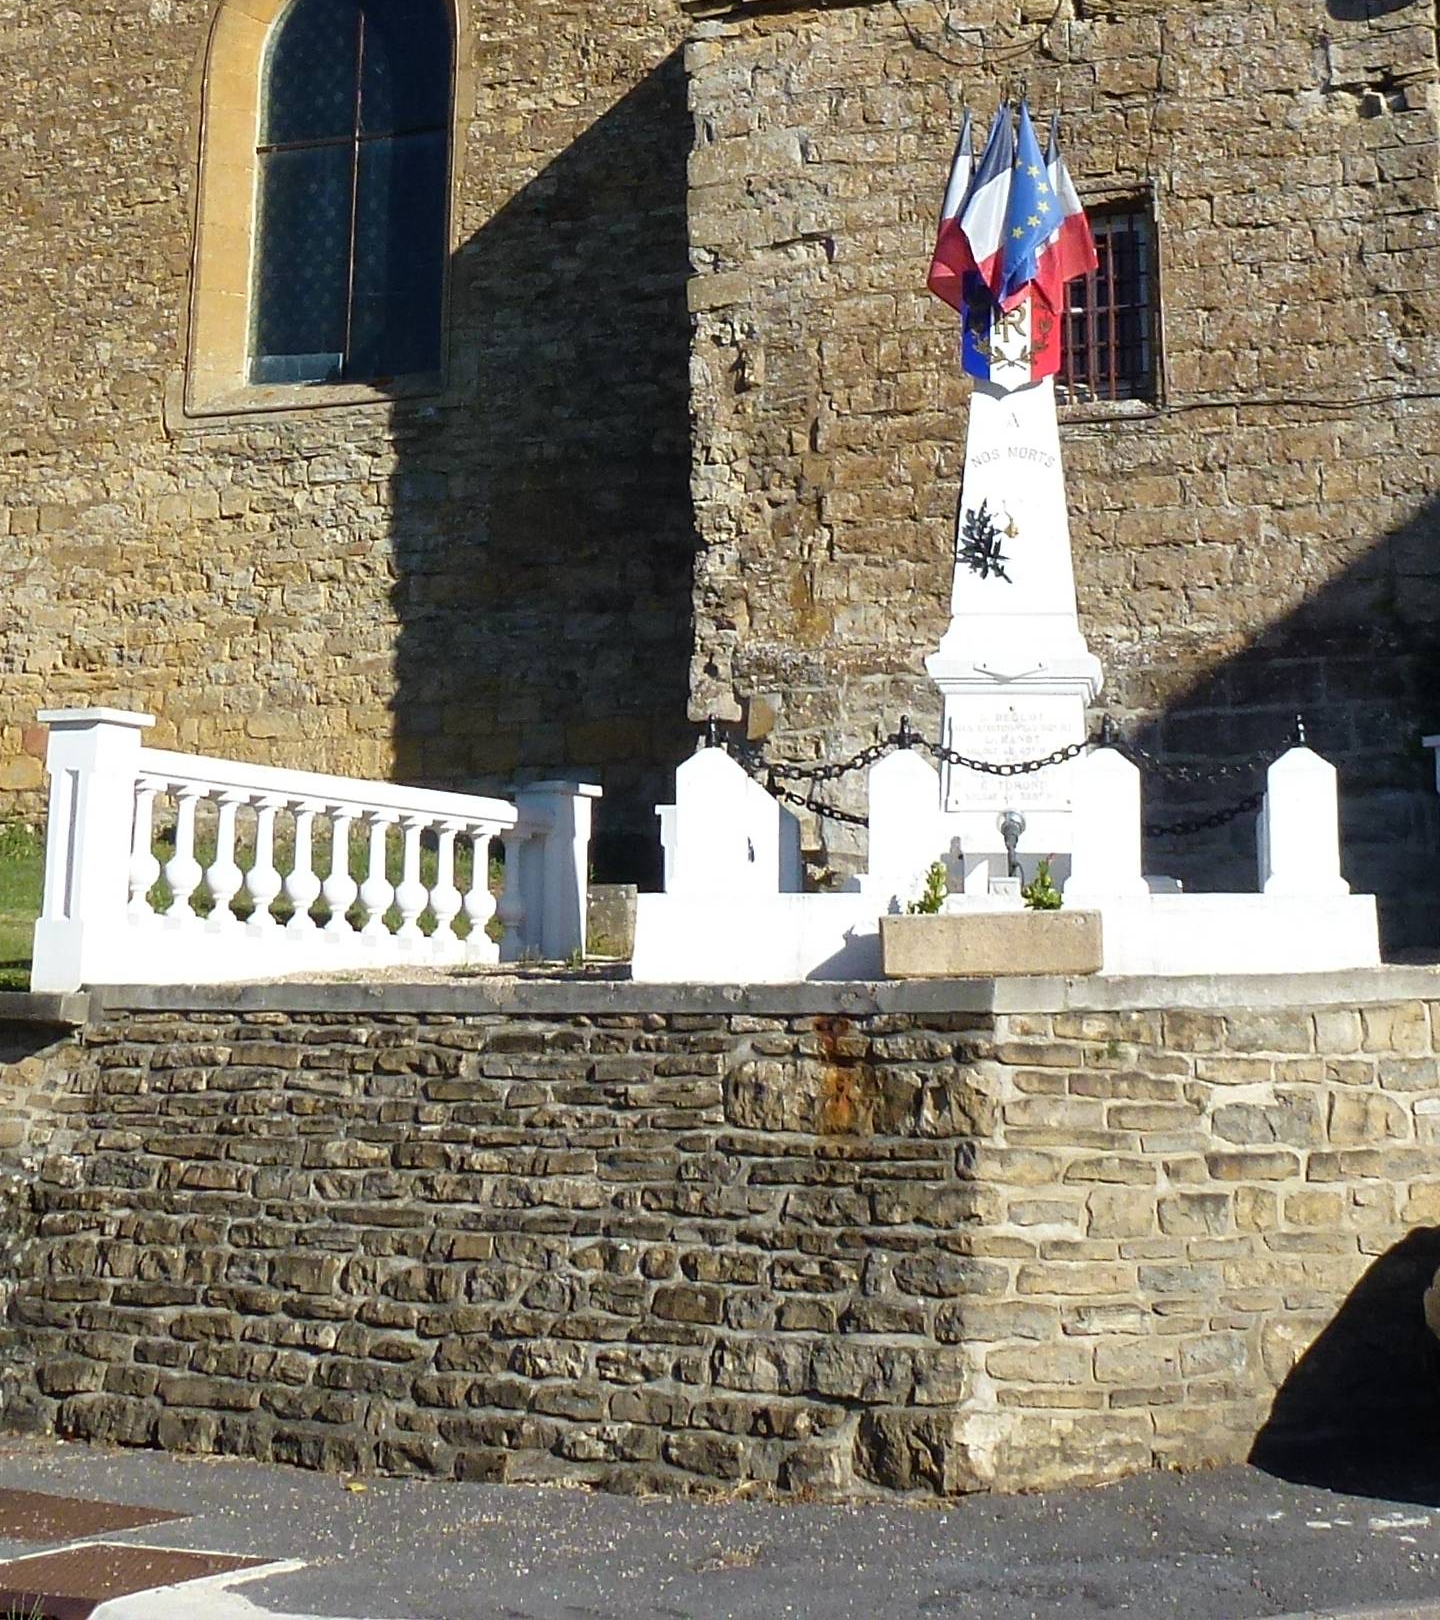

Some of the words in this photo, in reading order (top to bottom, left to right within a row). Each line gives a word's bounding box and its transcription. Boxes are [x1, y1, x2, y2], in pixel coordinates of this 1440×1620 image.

[1006, 412, 1020, 428] A
[971, 448, 1000, 468] NOS
[1007, 446, 1055, 468] MORTS
